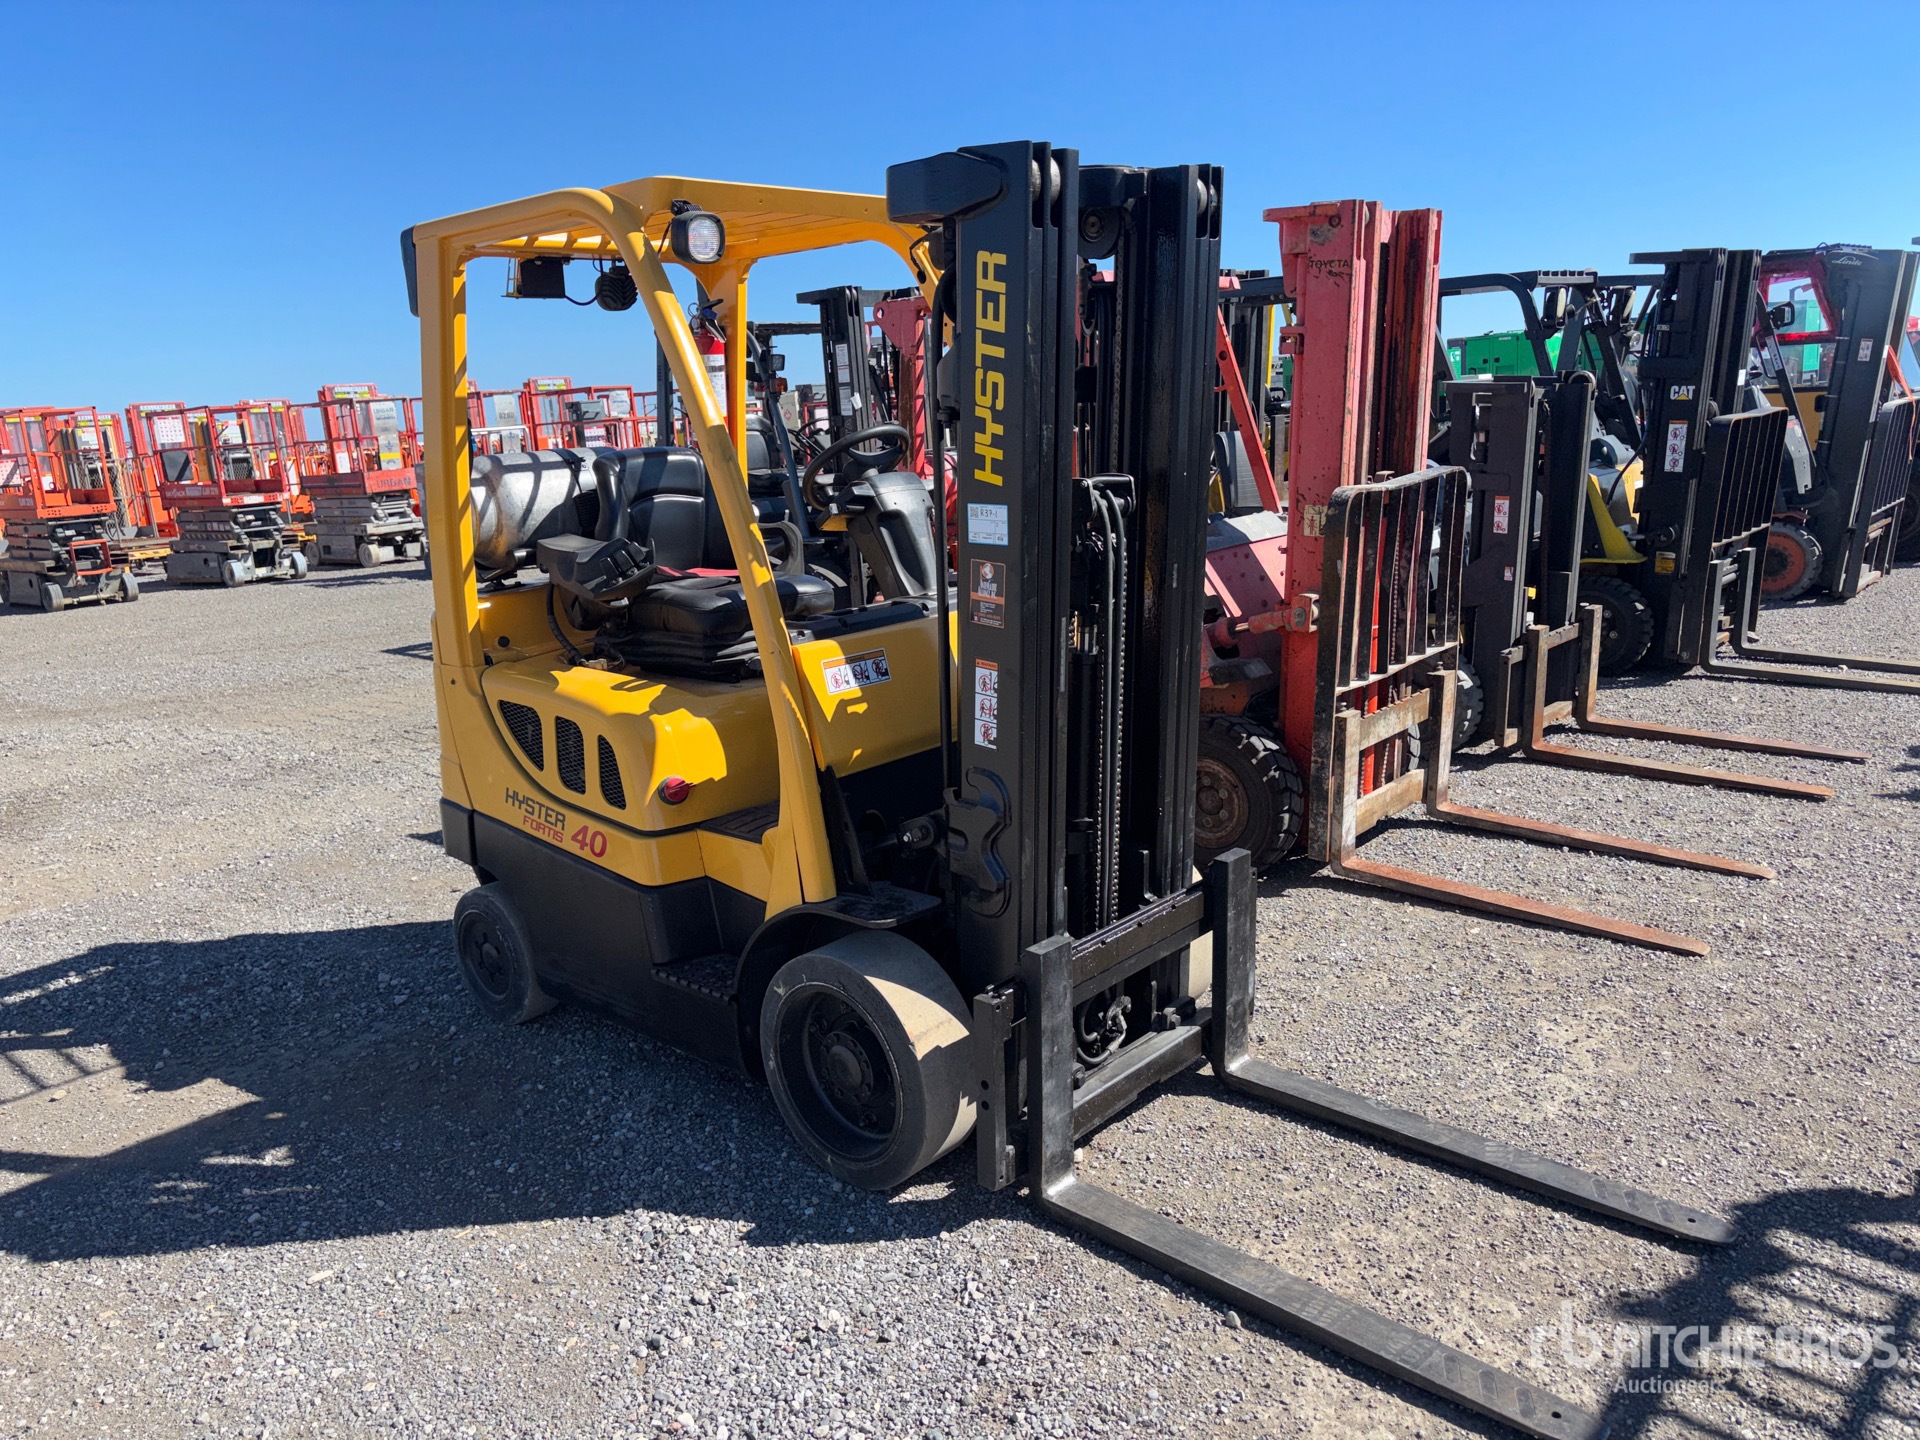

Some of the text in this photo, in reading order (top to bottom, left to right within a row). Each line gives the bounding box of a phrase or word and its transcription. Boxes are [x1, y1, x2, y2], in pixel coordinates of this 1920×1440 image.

[1831, 255, 1863, 266] Linde
[974, 250, 1007, 487] HYSTER
[1669, 385, 1696, 400] CAT
[376, 476, 412, 489] URBAN
[505, 787, 566, 831] HYSTER
[523, 815, 564, 843] FORTIS
[571, 825, 608, 858] 40
